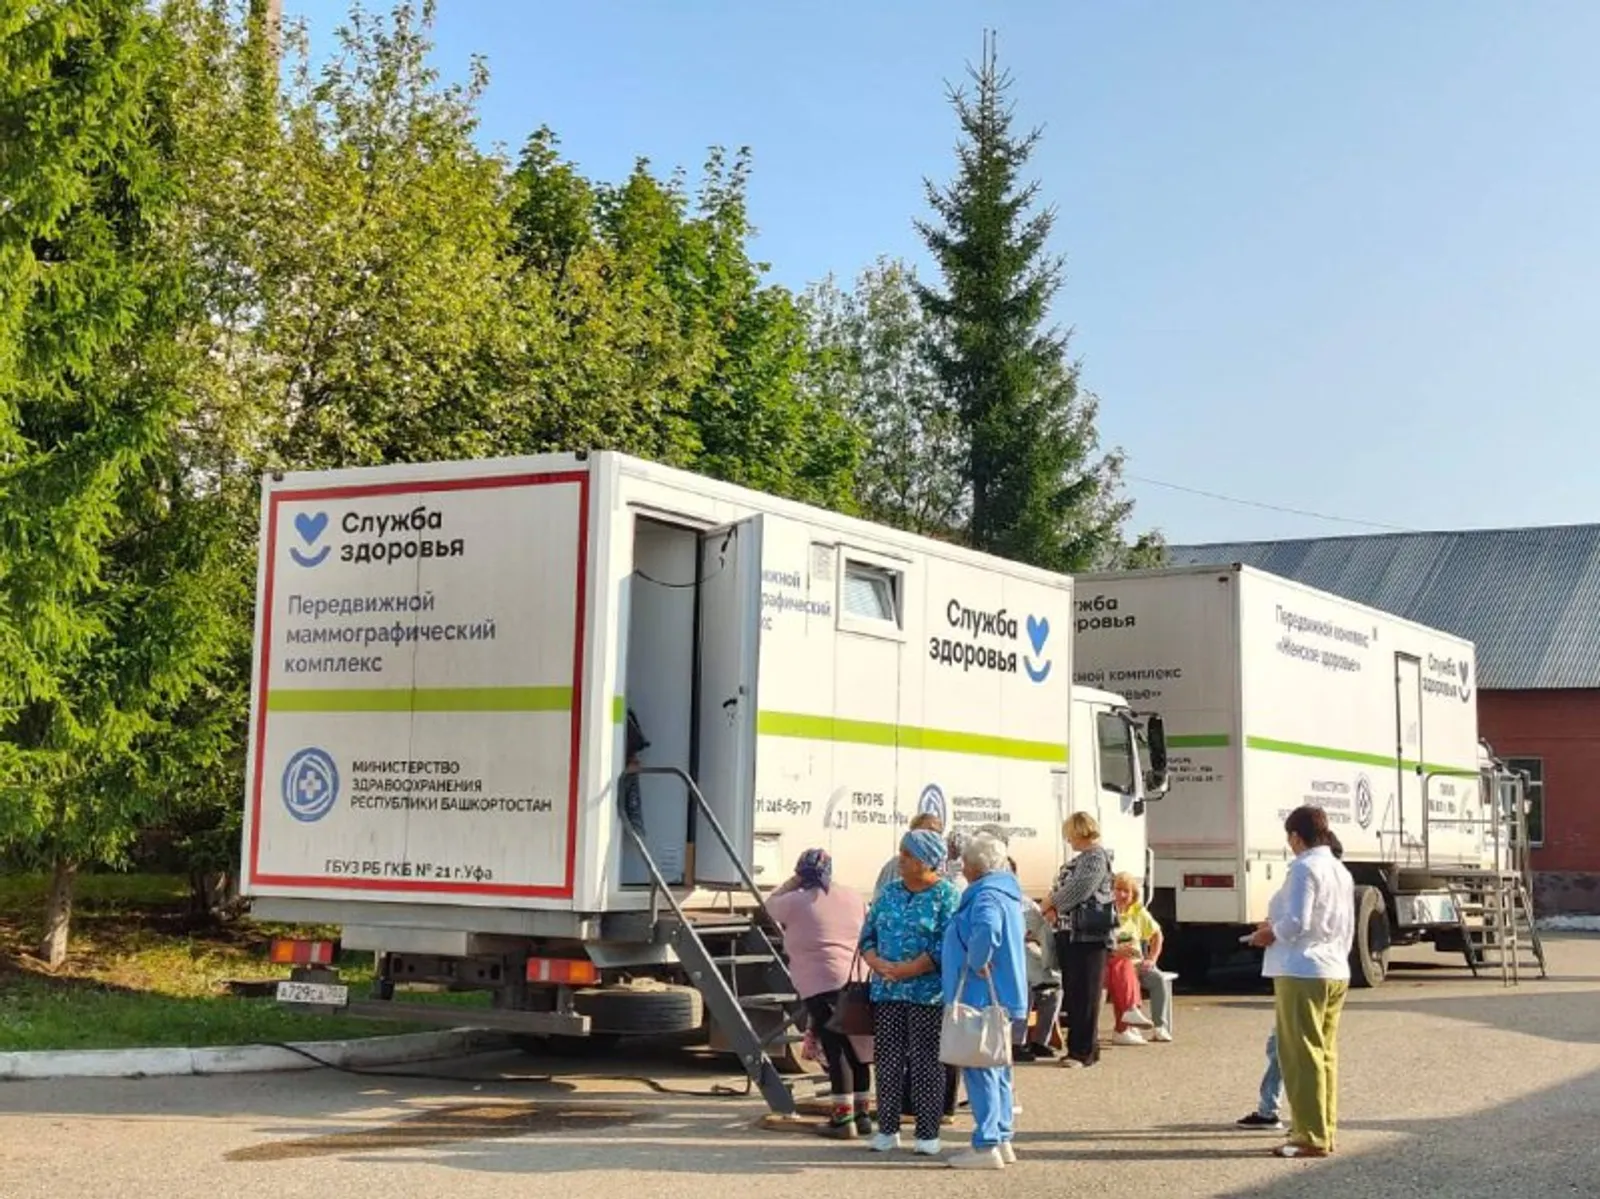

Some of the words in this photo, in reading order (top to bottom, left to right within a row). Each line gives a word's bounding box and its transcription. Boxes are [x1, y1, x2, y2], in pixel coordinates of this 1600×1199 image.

[342, 506, 442, 538] Служба
[340, 538, 465, 565] здоровья
[288, 590, 435, 619] Передвижной
[946, 598, 1018, 640] Служба
[286, 619, 497, 647] маммографический
[284, 655, 383, 673] комплекс
[929, 637, 1018, 673] здоровья
[1109, 668, 1182, 682] комплекс
[352, 761, 460, 775] МИНИСТЕРСТВО
[352, 778, 482, 793] ЗДРАВООХРАНЕНИЯ
[350, 795, 438, 811] РЕСПУБЛИКИ
[440, 798, 552, 812] БАШКОРТОСТАН
[325, 859, 360, 874] ГБУЗ
[362, 861, 381, 875] РБ
[384, 862, 411, 876] ГКБ
[435, 867, 450, 878] 21
[454, 865, 493, 882] г.Уфа
